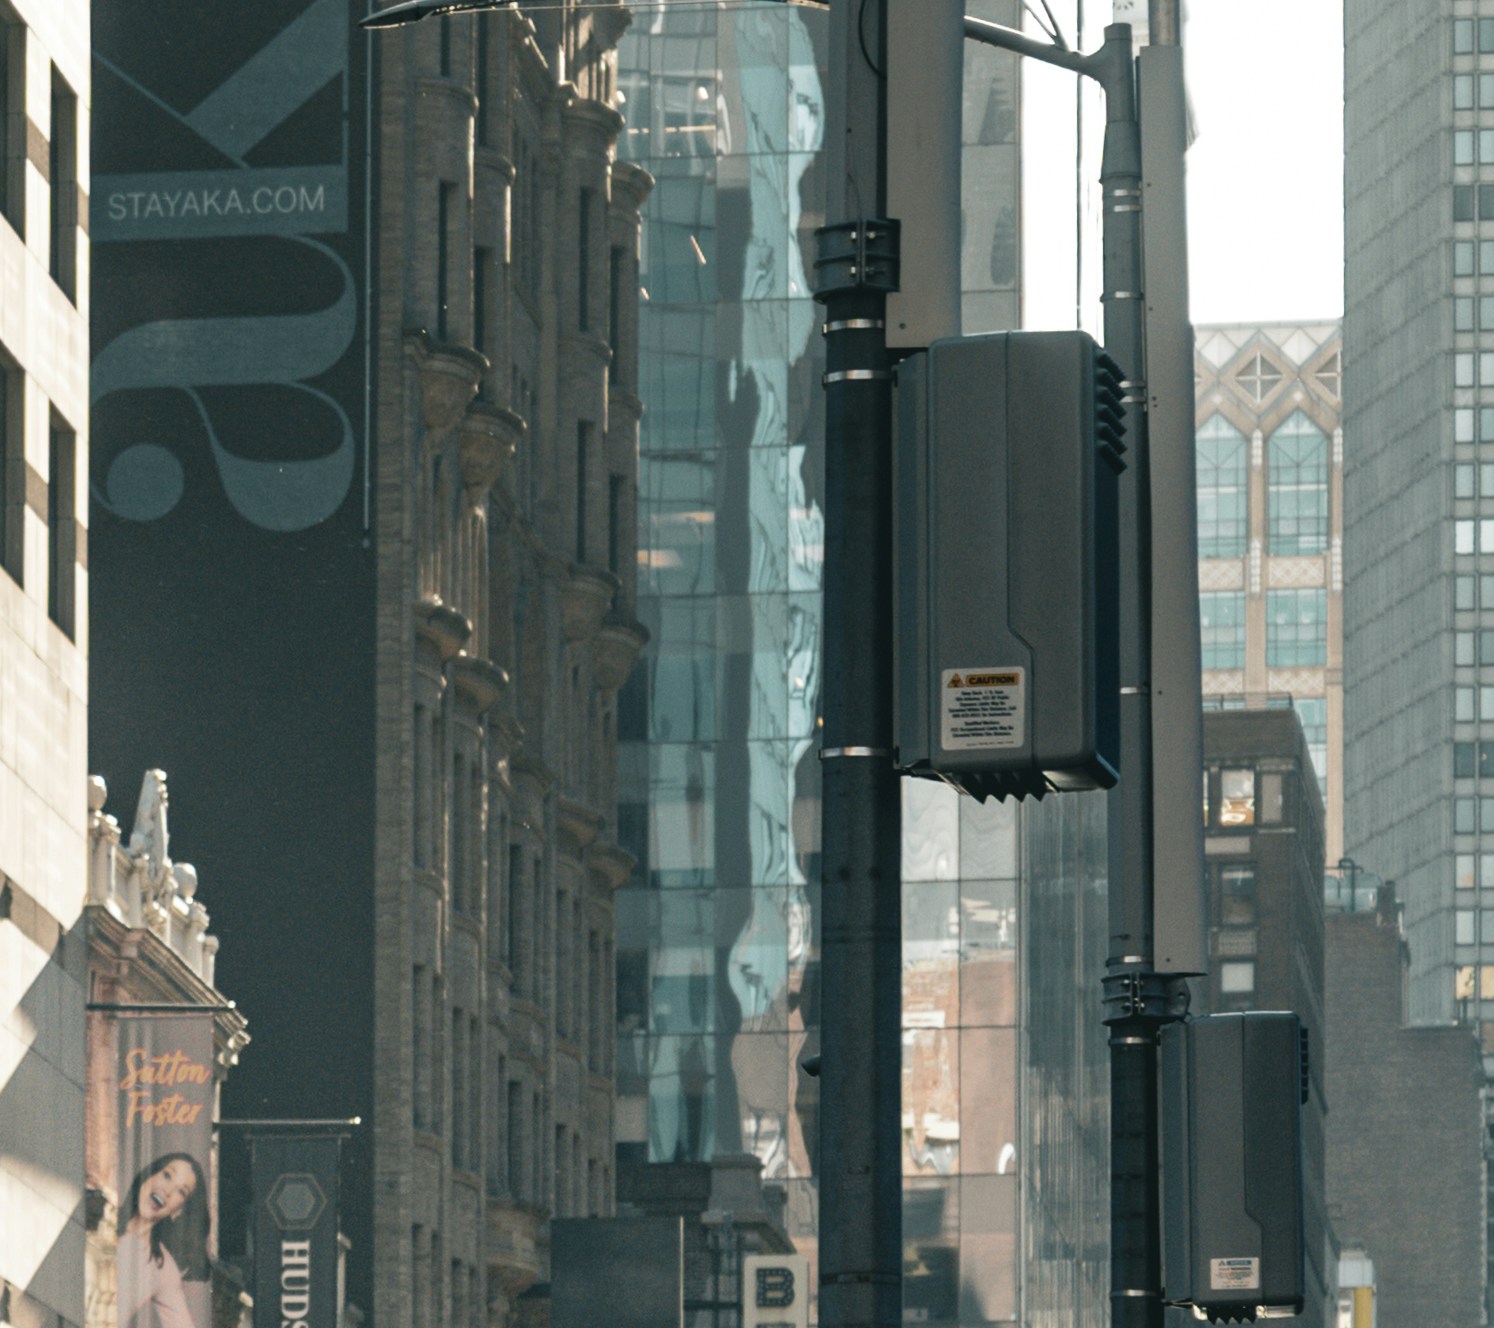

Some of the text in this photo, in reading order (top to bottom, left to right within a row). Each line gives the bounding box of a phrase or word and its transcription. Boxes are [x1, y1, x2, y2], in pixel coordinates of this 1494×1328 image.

[107, 185, 326, 221] STAYAKA.COM
[968, 676, 1015, 685] CAUTION
[120, 1047, 213, 1091] Sutton
[126, 1091, 204, 1128] Foster
